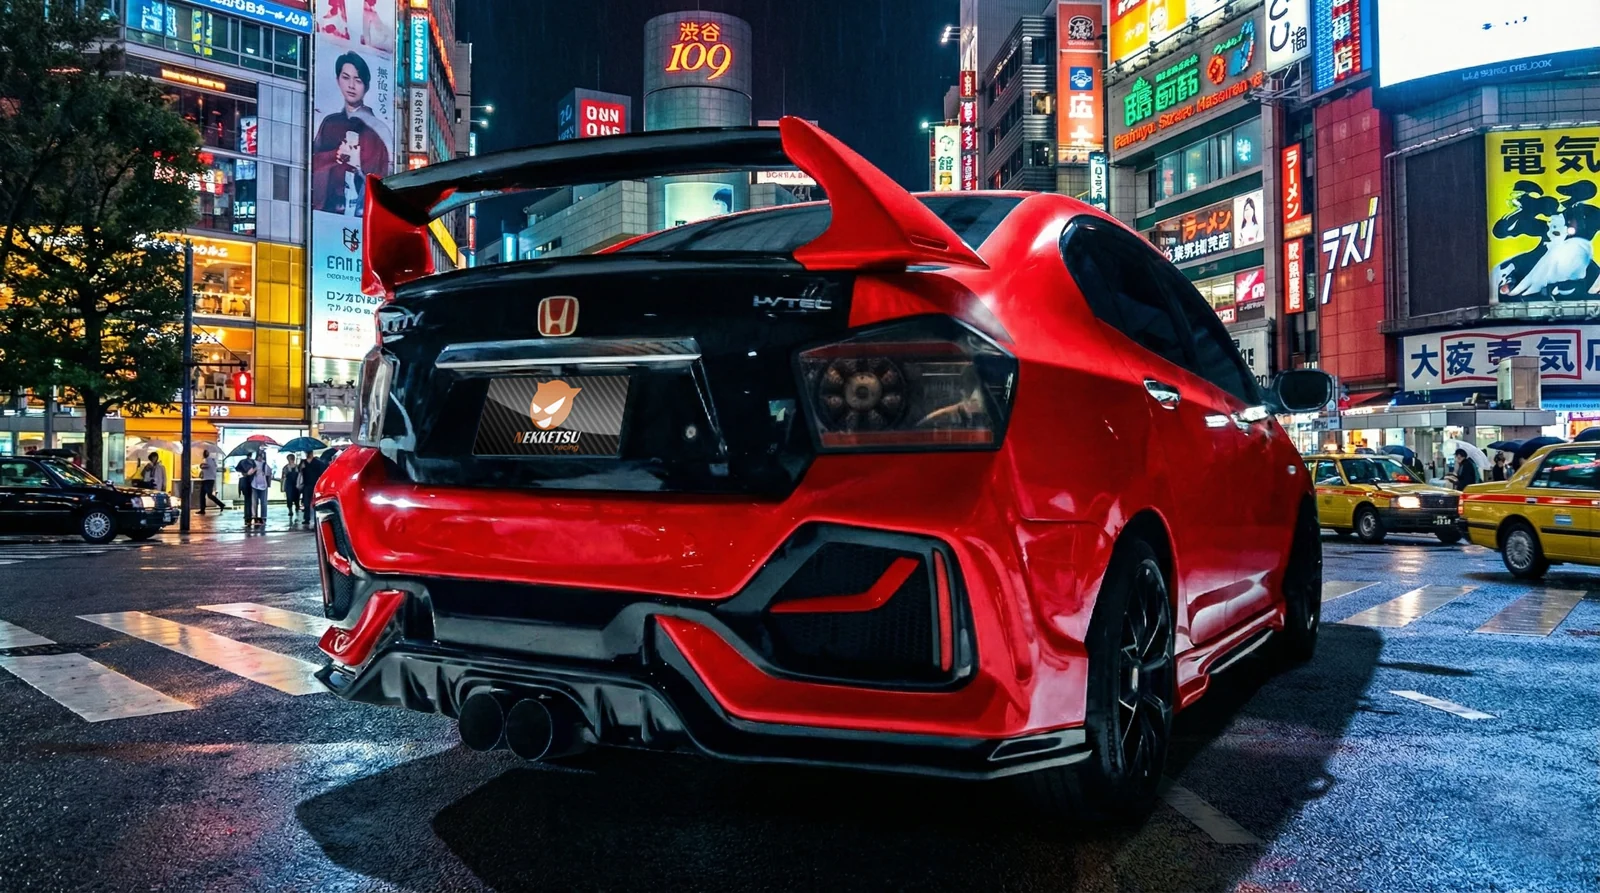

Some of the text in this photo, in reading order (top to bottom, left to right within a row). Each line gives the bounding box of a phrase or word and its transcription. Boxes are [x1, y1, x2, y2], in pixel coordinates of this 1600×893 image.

[680, 22, 721, 42] 渋谷
[665, 42, 732, 80] 109
[1501, 136, 1600, 175] 電気
[1286, 149, 1299, 219] ラーメン
[1182, 210, 1232, 240] ラーメン
[513, 430, 582, 444] NEKKETSU
[554, 444, 580, 452] racing
